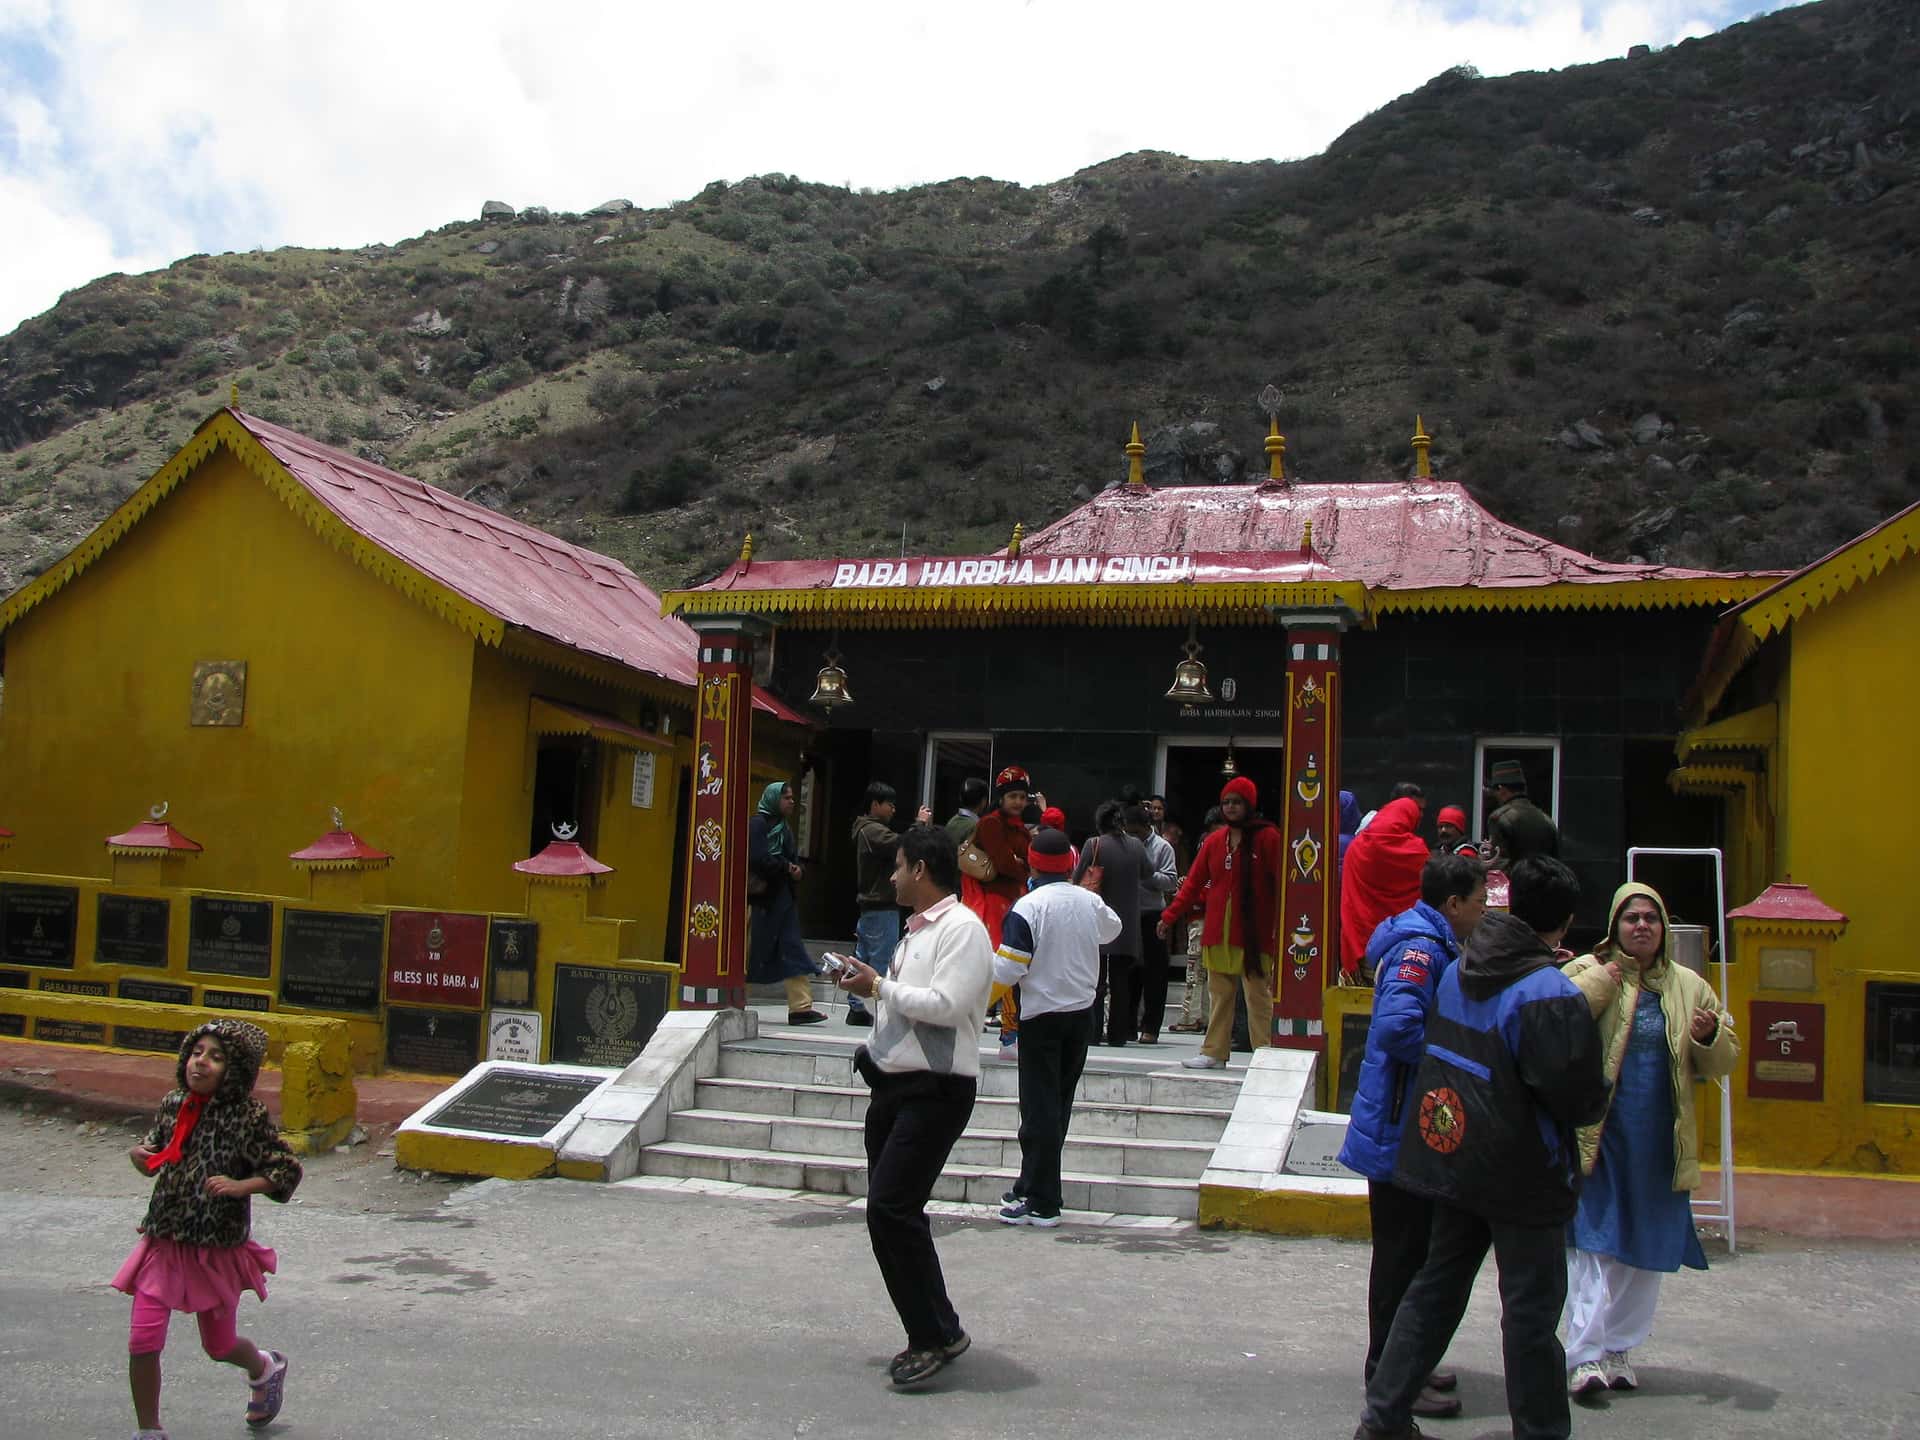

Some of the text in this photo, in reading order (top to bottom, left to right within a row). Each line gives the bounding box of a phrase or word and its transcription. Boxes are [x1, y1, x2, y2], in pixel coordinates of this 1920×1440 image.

[832, 555, 1192, 588] BABA HARBHAJAN SINGH
[393, 970, 480, 990] BLESS US BABA JI
[1780, 1040, 1792, 1055] 6
